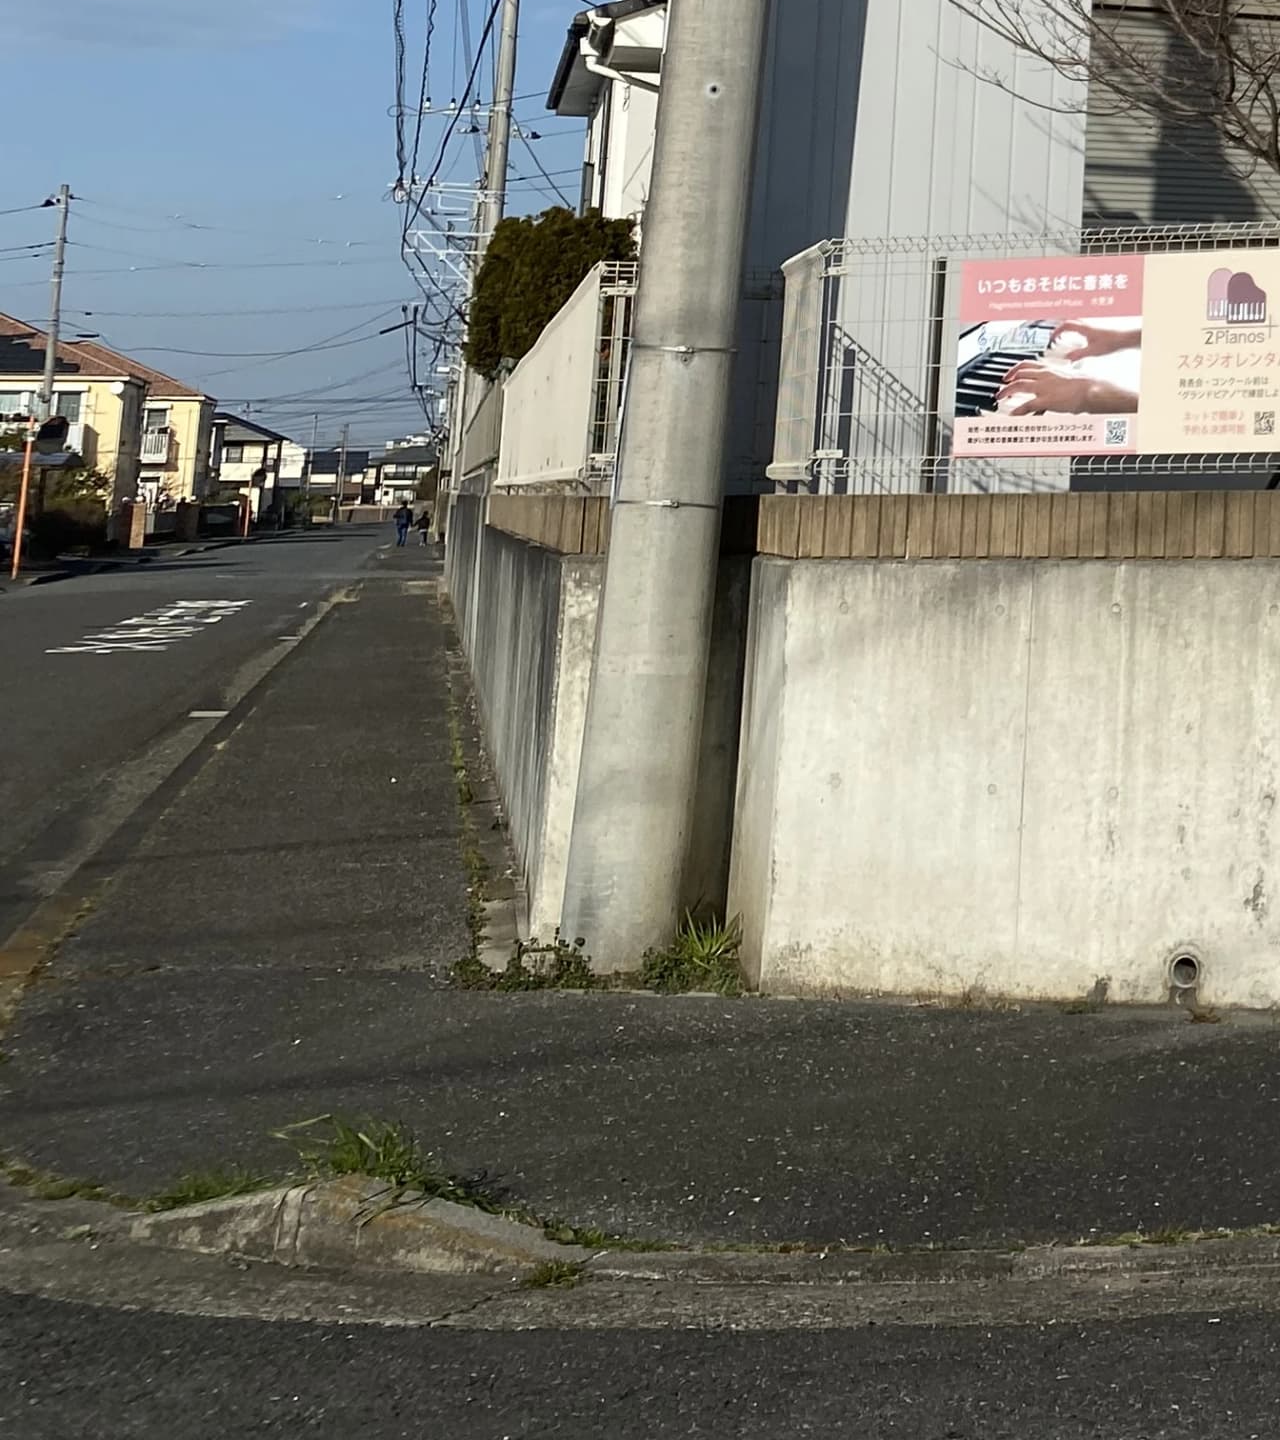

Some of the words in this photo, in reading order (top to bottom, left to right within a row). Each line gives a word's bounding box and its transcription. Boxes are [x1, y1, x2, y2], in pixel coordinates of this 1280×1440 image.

[978, 273, 1129, 294] いつもおそばに音楽を
